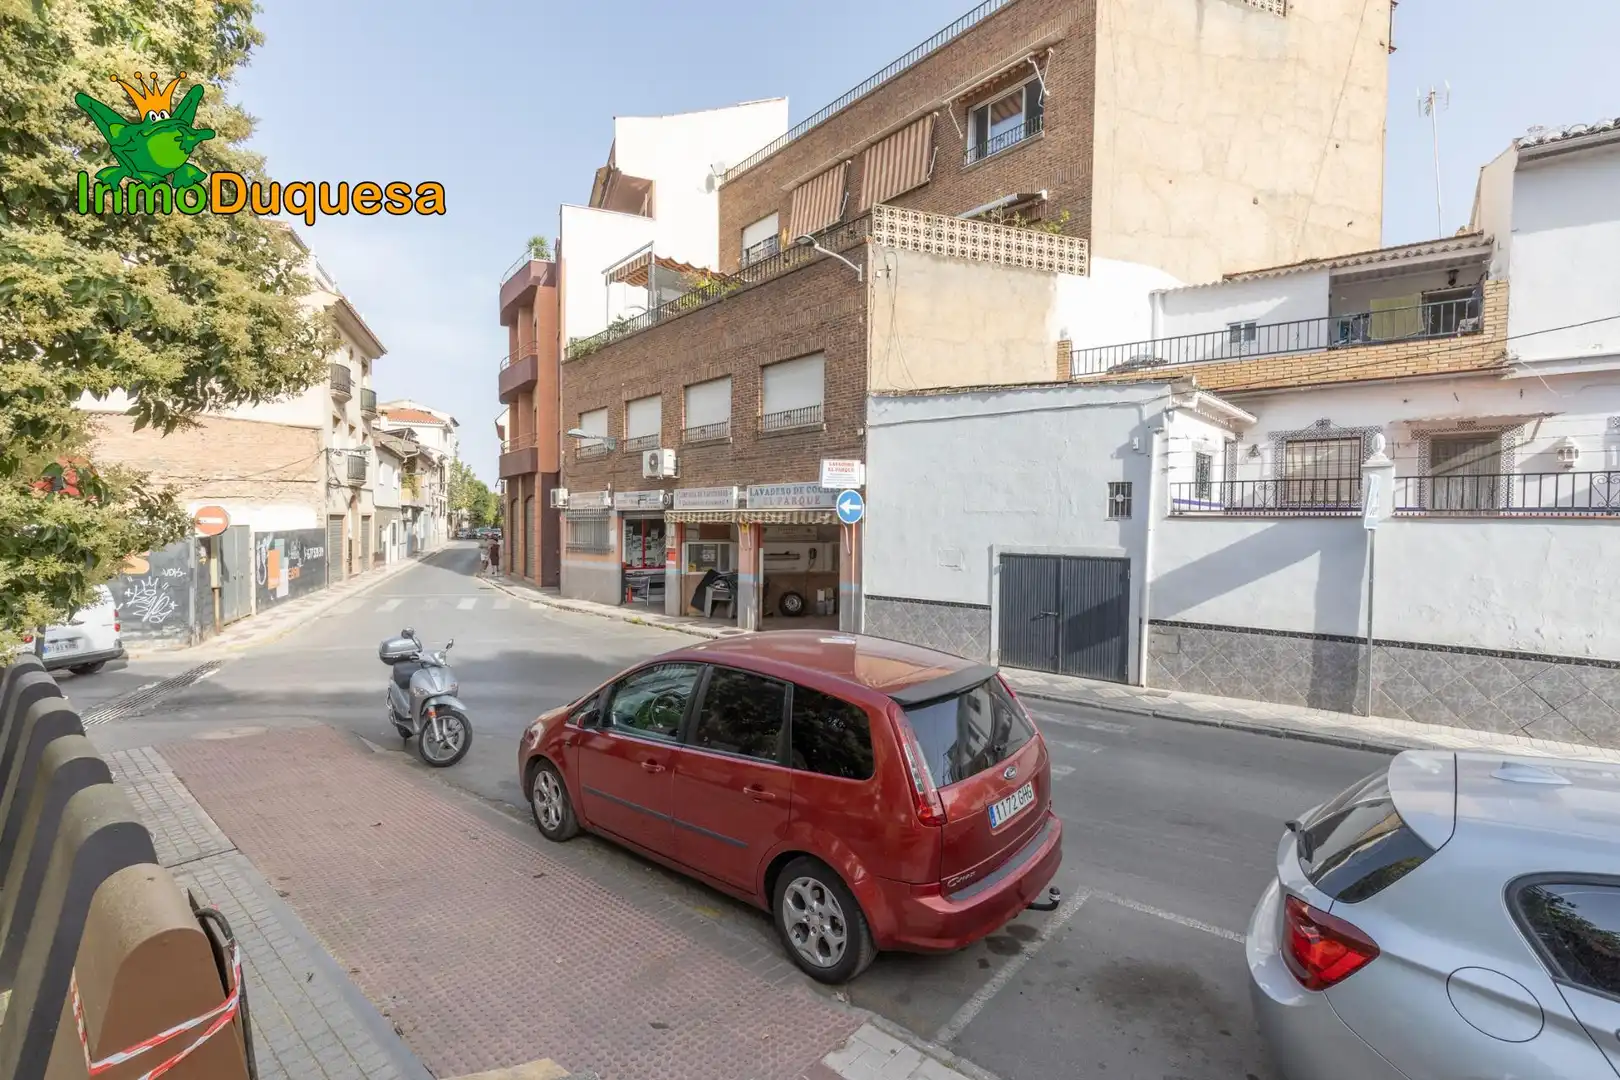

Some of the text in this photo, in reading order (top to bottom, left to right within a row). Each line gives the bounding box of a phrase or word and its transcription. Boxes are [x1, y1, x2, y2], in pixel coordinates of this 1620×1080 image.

[749, 487, 791, 497] LAVADERO
[793, 486, 805, 495] DE
[763, 495, 821, 506] EL PARQUE
[996, 784, 1033, 821] 1172 GHG
